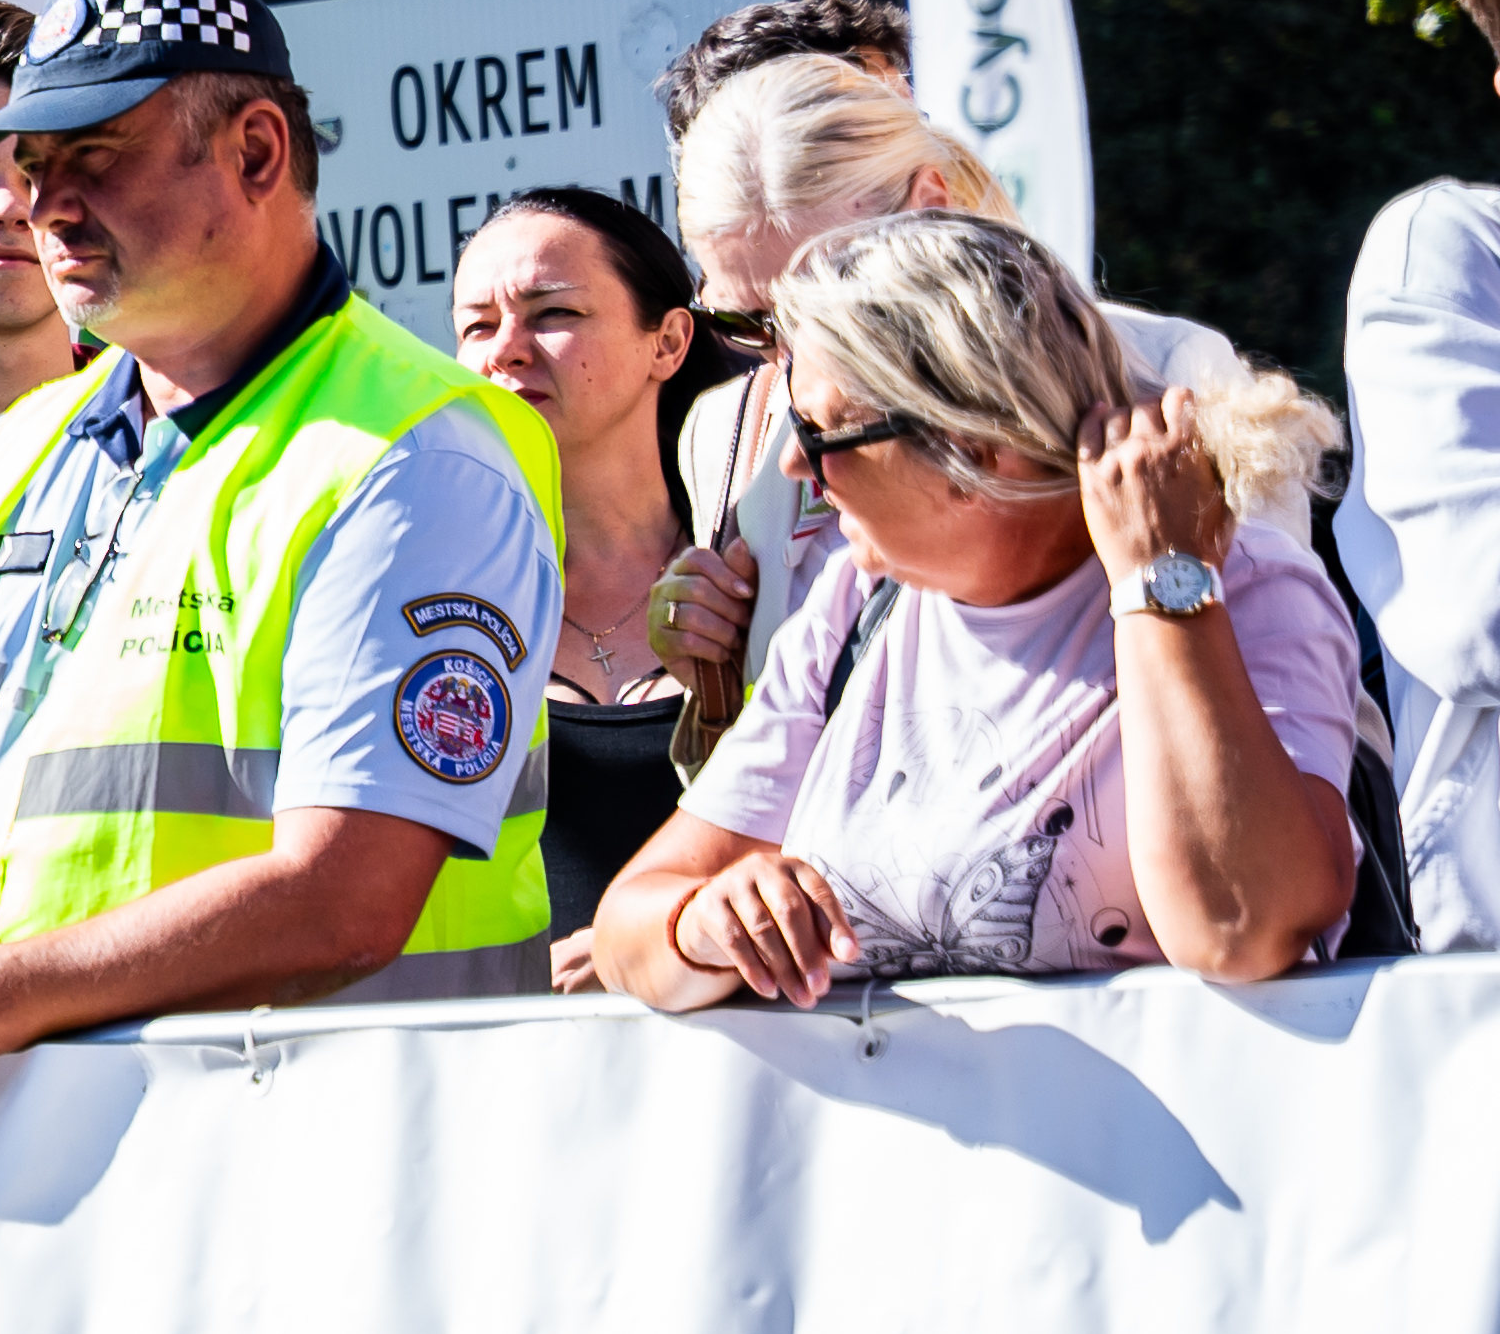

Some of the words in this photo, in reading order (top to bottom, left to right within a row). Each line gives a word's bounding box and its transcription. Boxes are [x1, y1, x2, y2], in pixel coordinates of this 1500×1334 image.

[390, 42, 604, 152] OKREM
[414, 602, 479, 625] MESTSKÁ
[443, 658, 495, 691] KOŠICE
